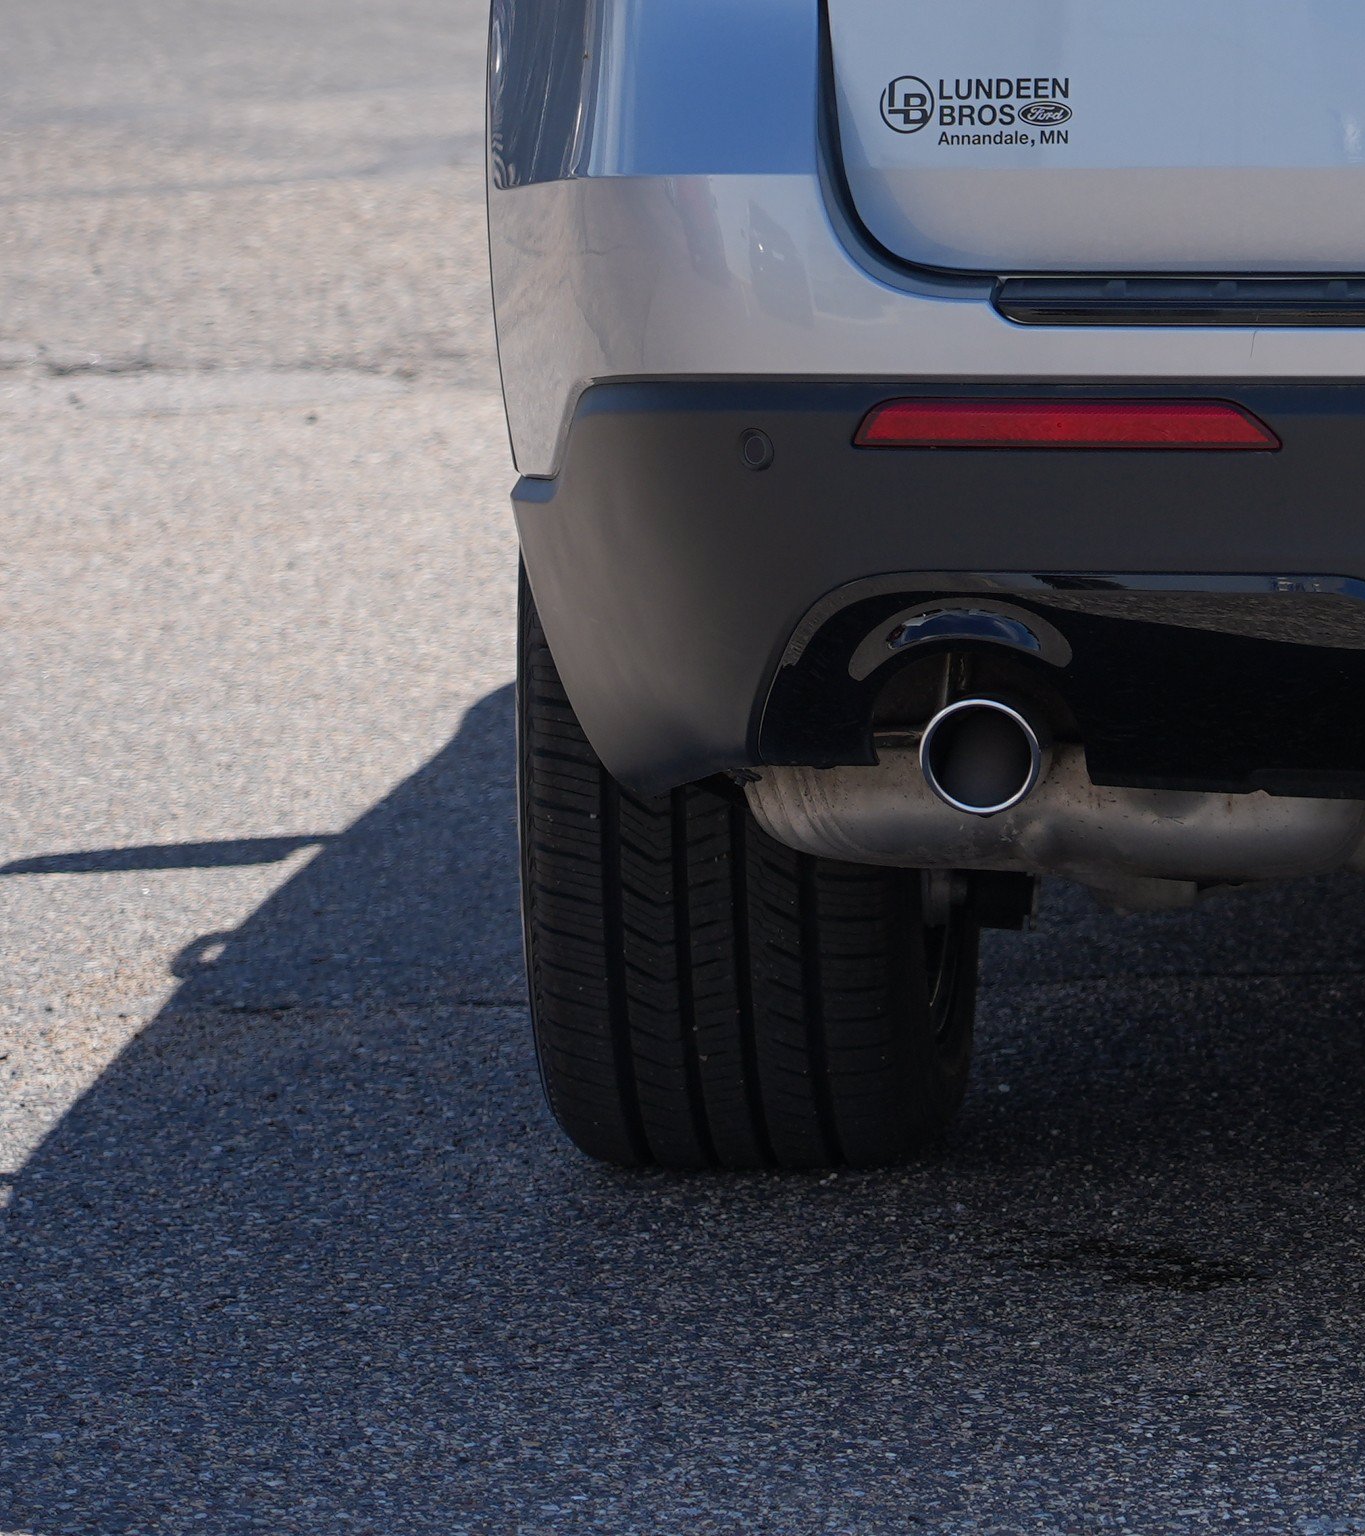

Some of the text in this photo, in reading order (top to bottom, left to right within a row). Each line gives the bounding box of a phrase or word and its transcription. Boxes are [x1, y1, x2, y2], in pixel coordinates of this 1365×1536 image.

[938, 77, 1070, 101] LUNDEEN
[938, 103, 1064, 127] BROS Ford
[938, 129, 1070, 148] Annandale, MN
